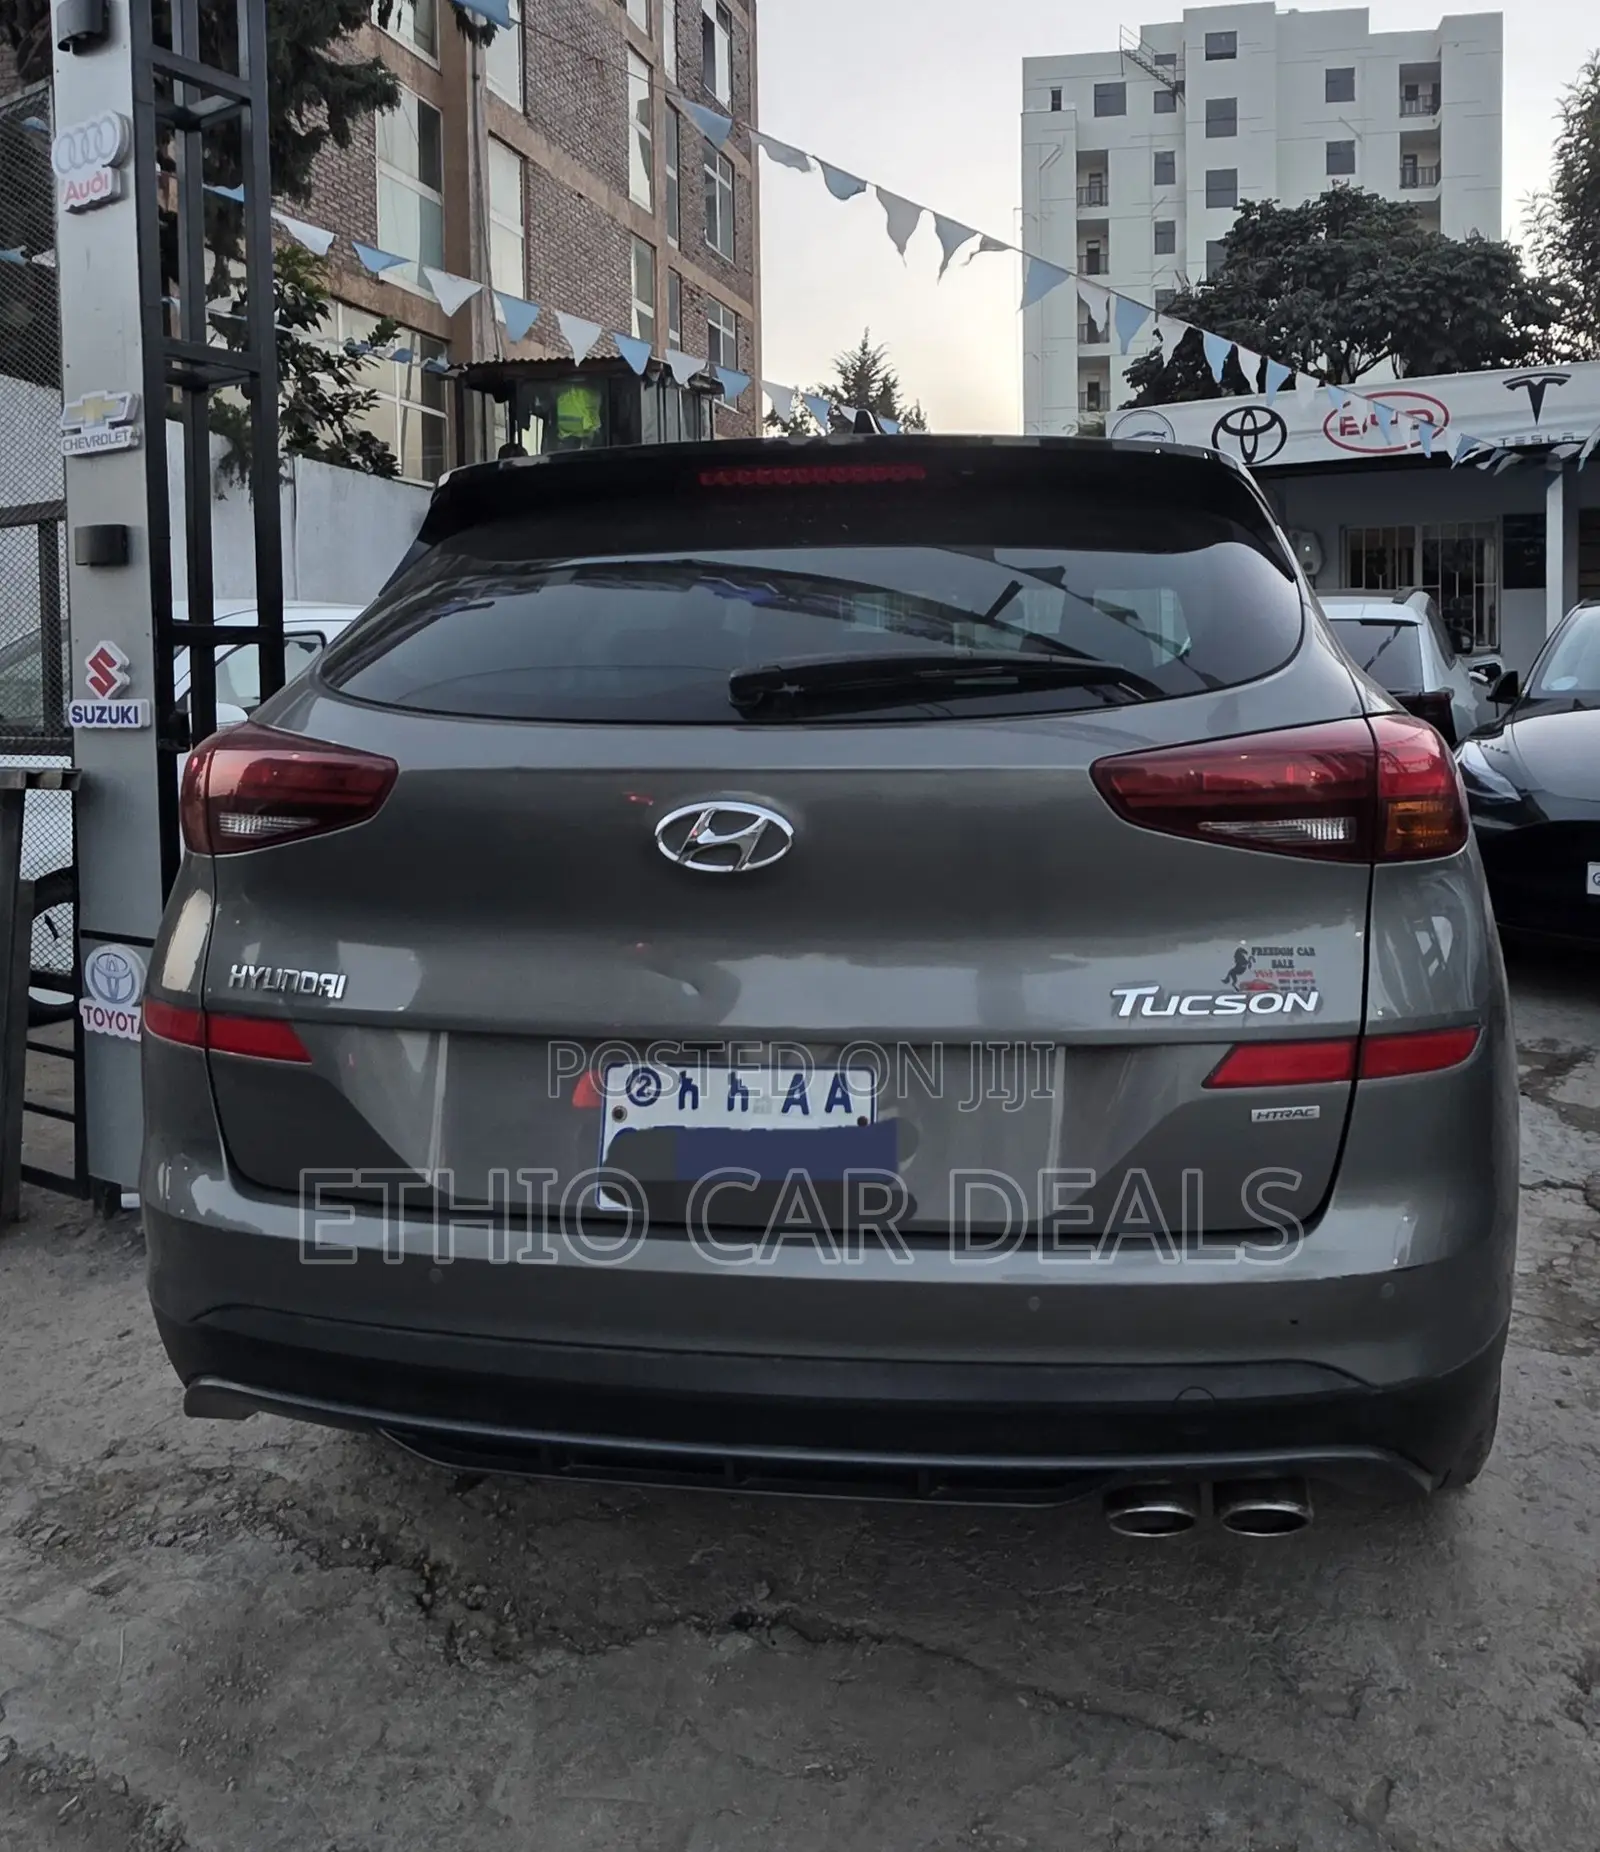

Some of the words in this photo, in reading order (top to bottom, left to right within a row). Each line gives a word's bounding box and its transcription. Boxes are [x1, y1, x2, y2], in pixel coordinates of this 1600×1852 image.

[64, 171, 108, 204] Audi
[62, 430, 129, 452] CHEVROLET
[1498, 432, 1575, 447] TESLA
[71, 705, 139, 724] SUZUKI
[1296, 946, 1316, 956] CAR
[228, 964, 347, 999] HYUNDAI
[1111, 985, 1319, 1017] TUCSON
[1256, 1107, 1317, 1121] HTRAC
